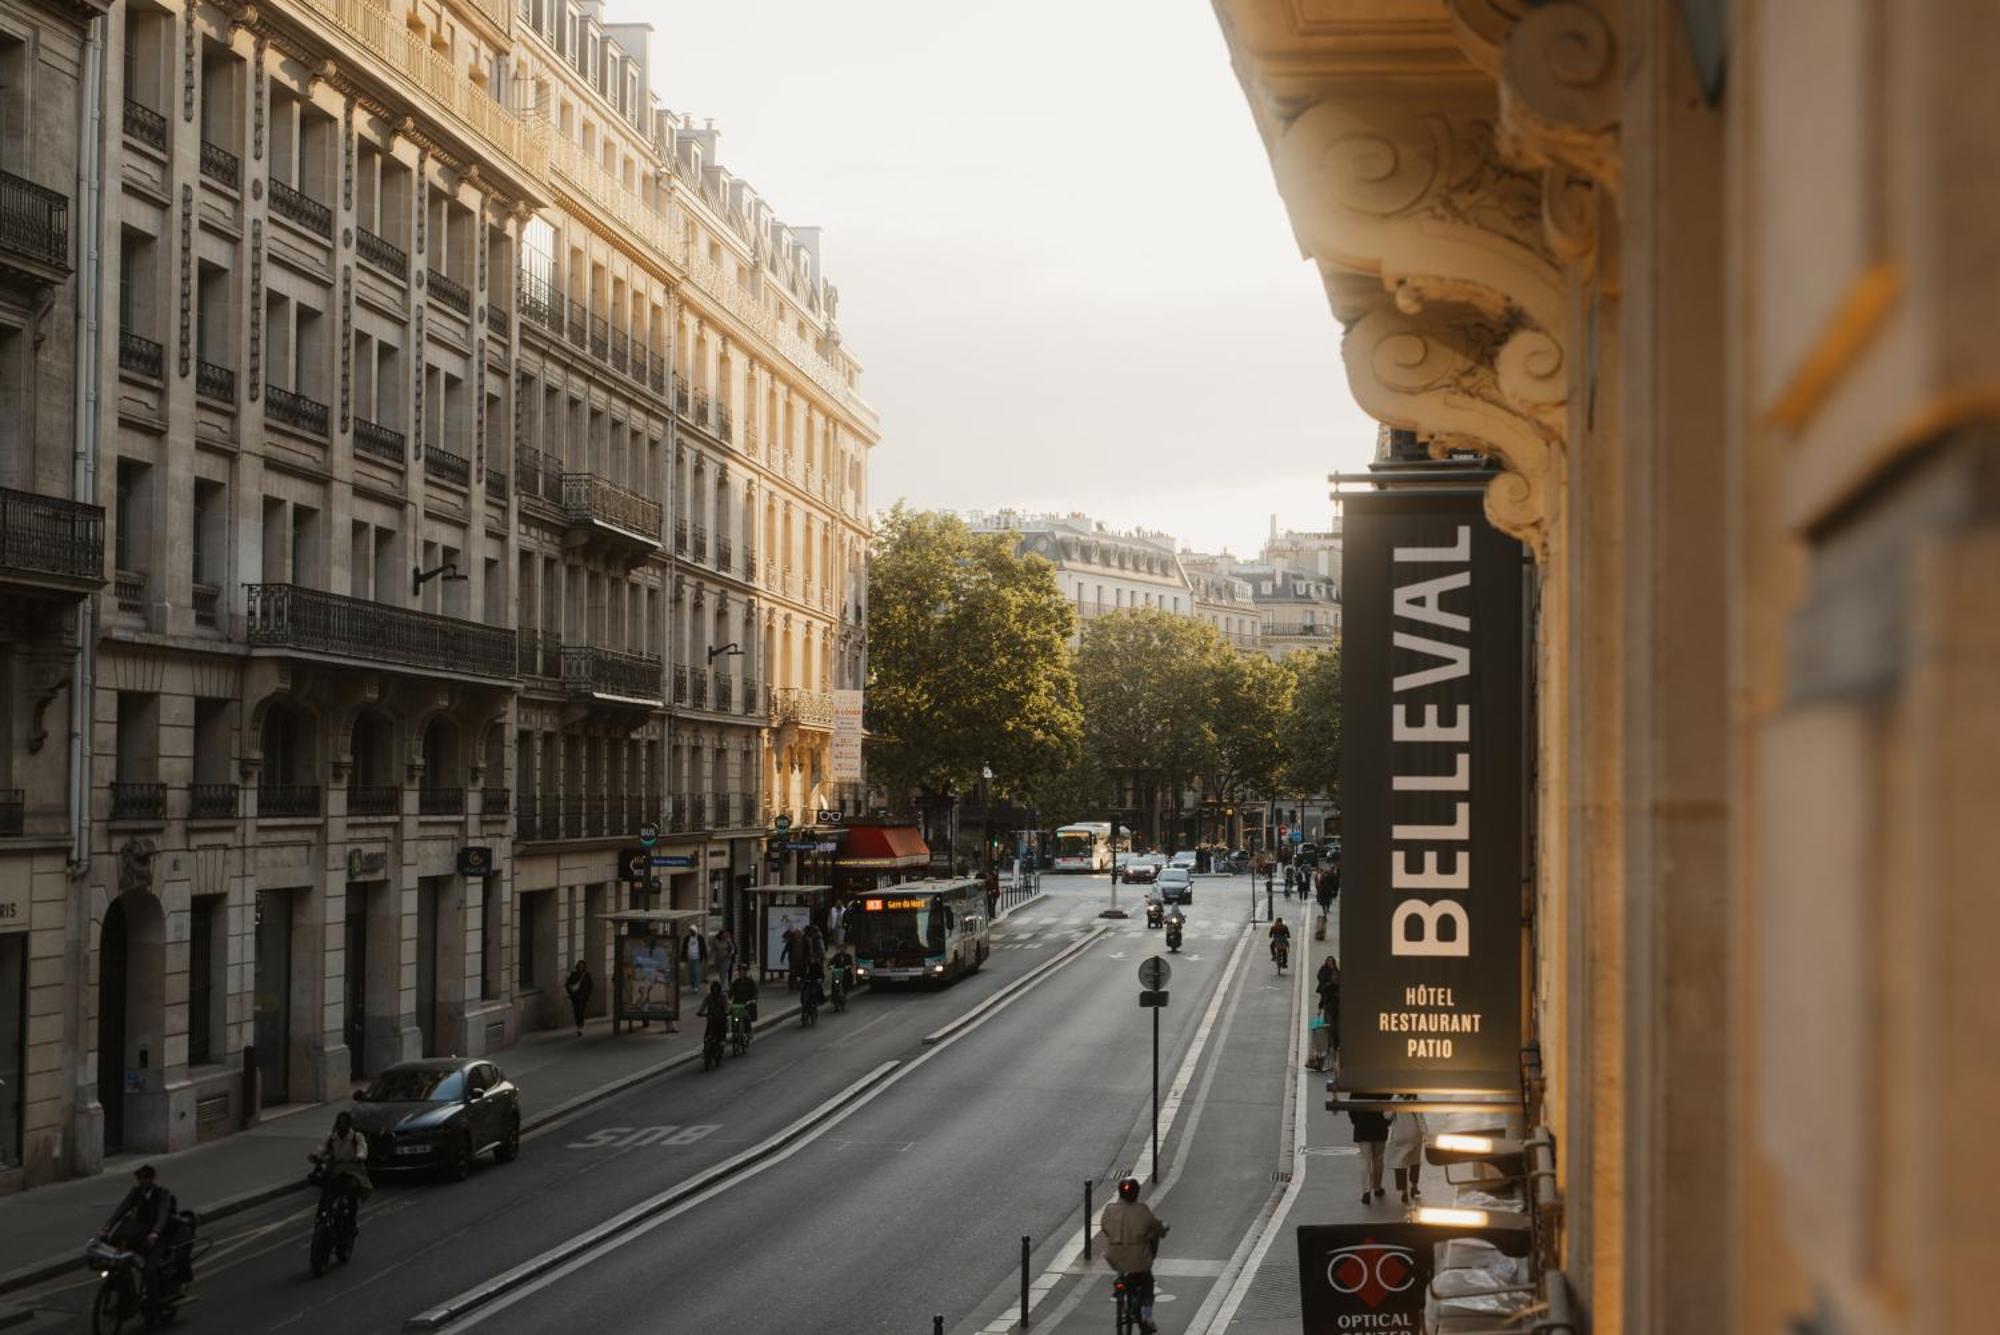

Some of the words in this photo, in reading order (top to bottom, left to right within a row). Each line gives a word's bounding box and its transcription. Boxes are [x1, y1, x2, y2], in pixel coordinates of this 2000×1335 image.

[1392, 525, 1471, 957] BELLEVAL
[640, 827, 656, 837] BUS
[1406, 984, 1455, 1006] HÔTEL
[1379, 1012, 1482, 1032] RESTAURANT
[1407, 1038, 1453, 1058] PATIO
[565, 1123, 724, 1148] BUS
[1337, 1313, 1413, 1329] OPTICAL
